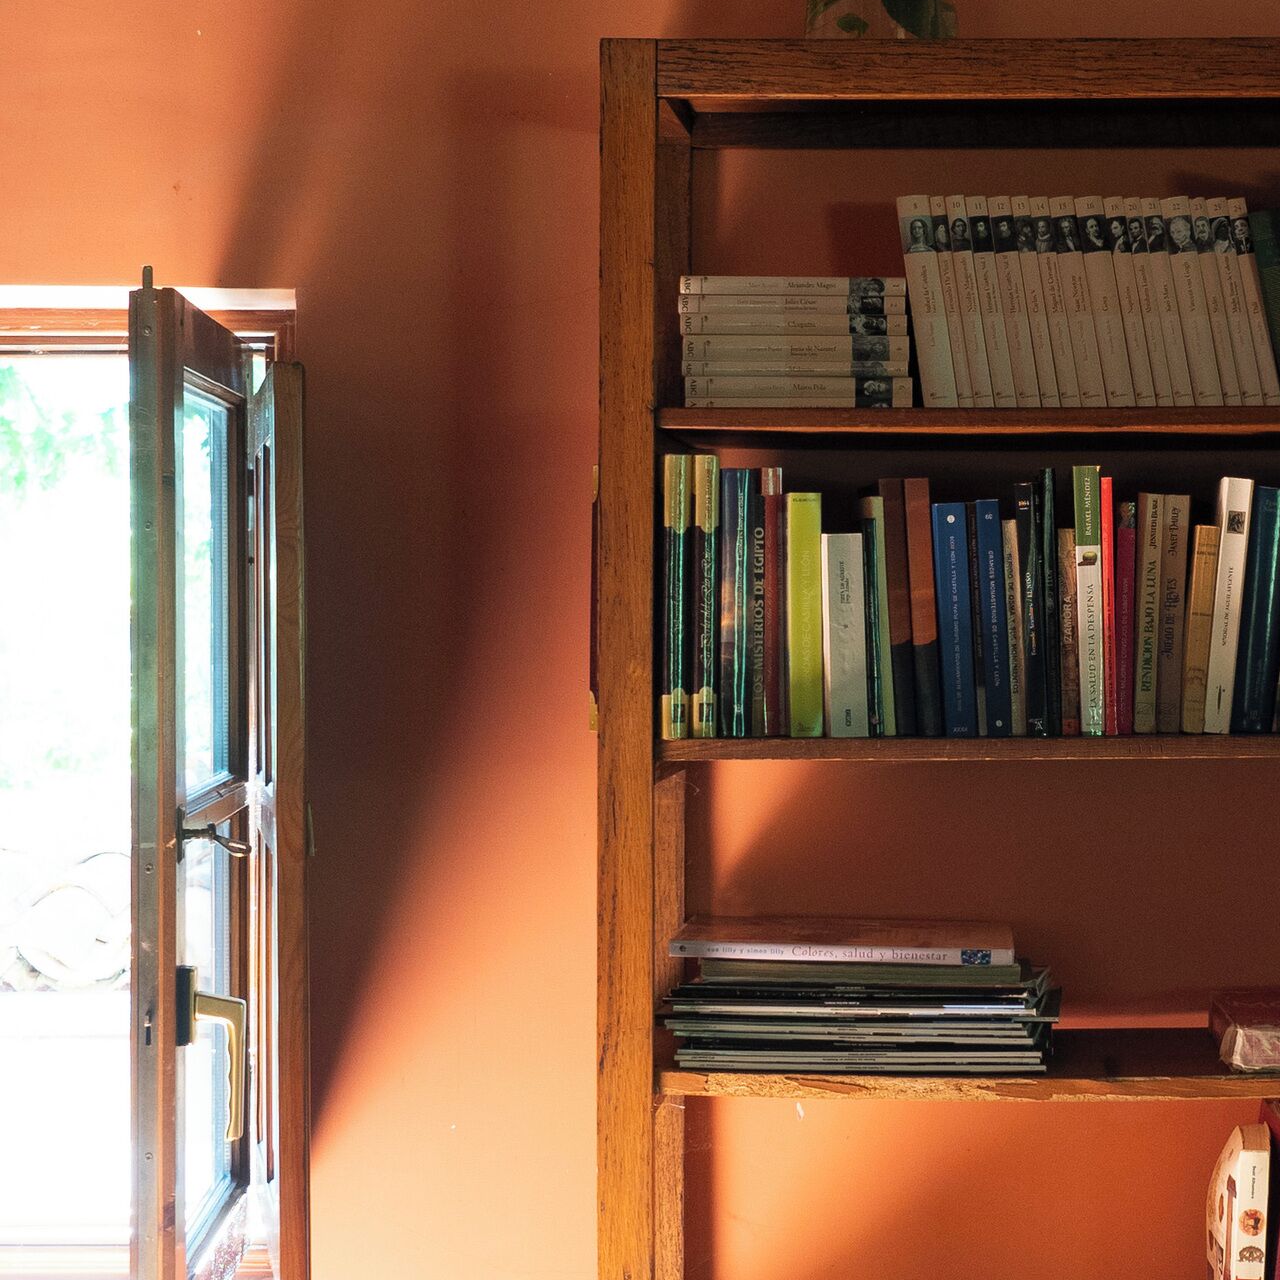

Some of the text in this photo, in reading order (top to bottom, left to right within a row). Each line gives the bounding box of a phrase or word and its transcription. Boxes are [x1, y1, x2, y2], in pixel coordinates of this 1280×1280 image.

[1083, 477, 1092, 536] RAFAEL MÉNDEZ
[1149, 518, 1157, 549] JENNIFER
[1168, 534, 1178, 556] JANET
[987, 550, 996, 579] GRANDES
[989, 581, 997, 623] MONASTERIOS
[1007, 582, 1014, 593] DE
[753, 527, 764, 700] LOS MISTERIOS DE EGIPTO
[1008, 594, 1016, 616] OSMA
[1062, 595, 1072, 643] ZAMORA
[1086, 584, 1095, 631] DESPENSA
[1160, 578, 1180, 657] JUEGO DE REYES
[991, 625, 998, 634] DE
[1088, 633, 1095, 645] LA
[1140, 560, 1156, 692] RENDICION BAJO LA LUNA
[991, 634, 999, 664] CASTILLA
[1089, 648, 1095, 660] EN
[1089, 697, 1097, 708] LA
[722, 946, 736, 954] lilly
[770, 947, 784, 955] lilly
[791, 946, 948, 962] Colores, salud y bienestar
